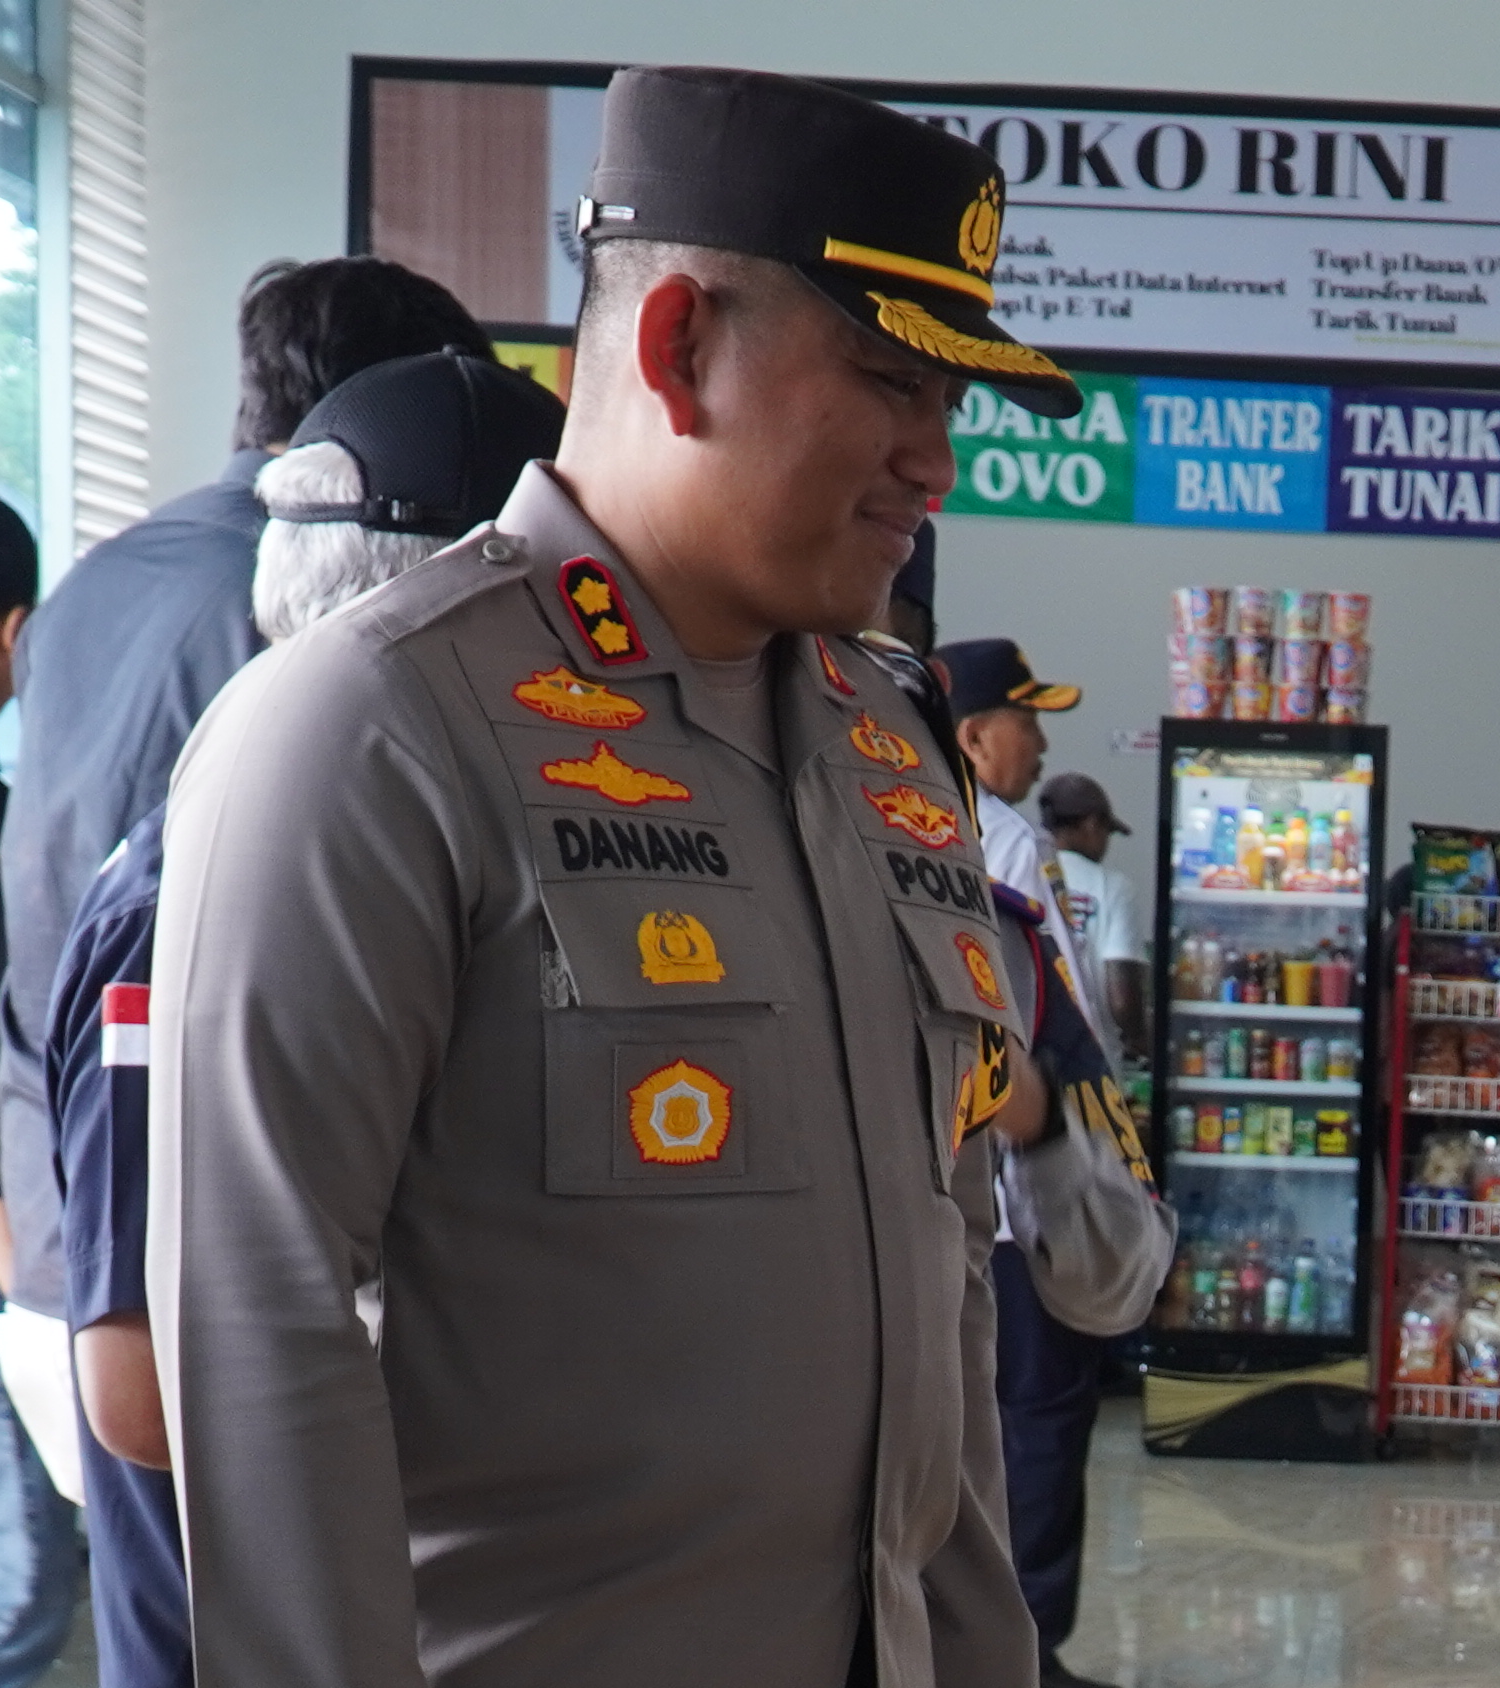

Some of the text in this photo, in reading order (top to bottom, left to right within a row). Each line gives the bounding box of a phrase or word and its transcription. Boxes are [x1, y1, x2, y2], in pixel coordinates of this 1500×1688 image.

[906, 114, 1452, 202] OKO RINI
[1122, 269, 1183, 291] Data
[1186, 272, 1287, 296] Internet
[1312, 249, 1360, 275] Top
[993, 298, 1021, 319] op
[1312, 279, 1487, 304] Transfer Bank
[1311, 308, 1457, 333] Tarik Tunai
[1143, 394, 1322, 453] TRANFER
[971, 448, 1106, 507] OVO
[1174, 459, 1286, 516] BANK
[553, 817, 729, 877] DANANG
[886, 850, 991, 920] POLRI
